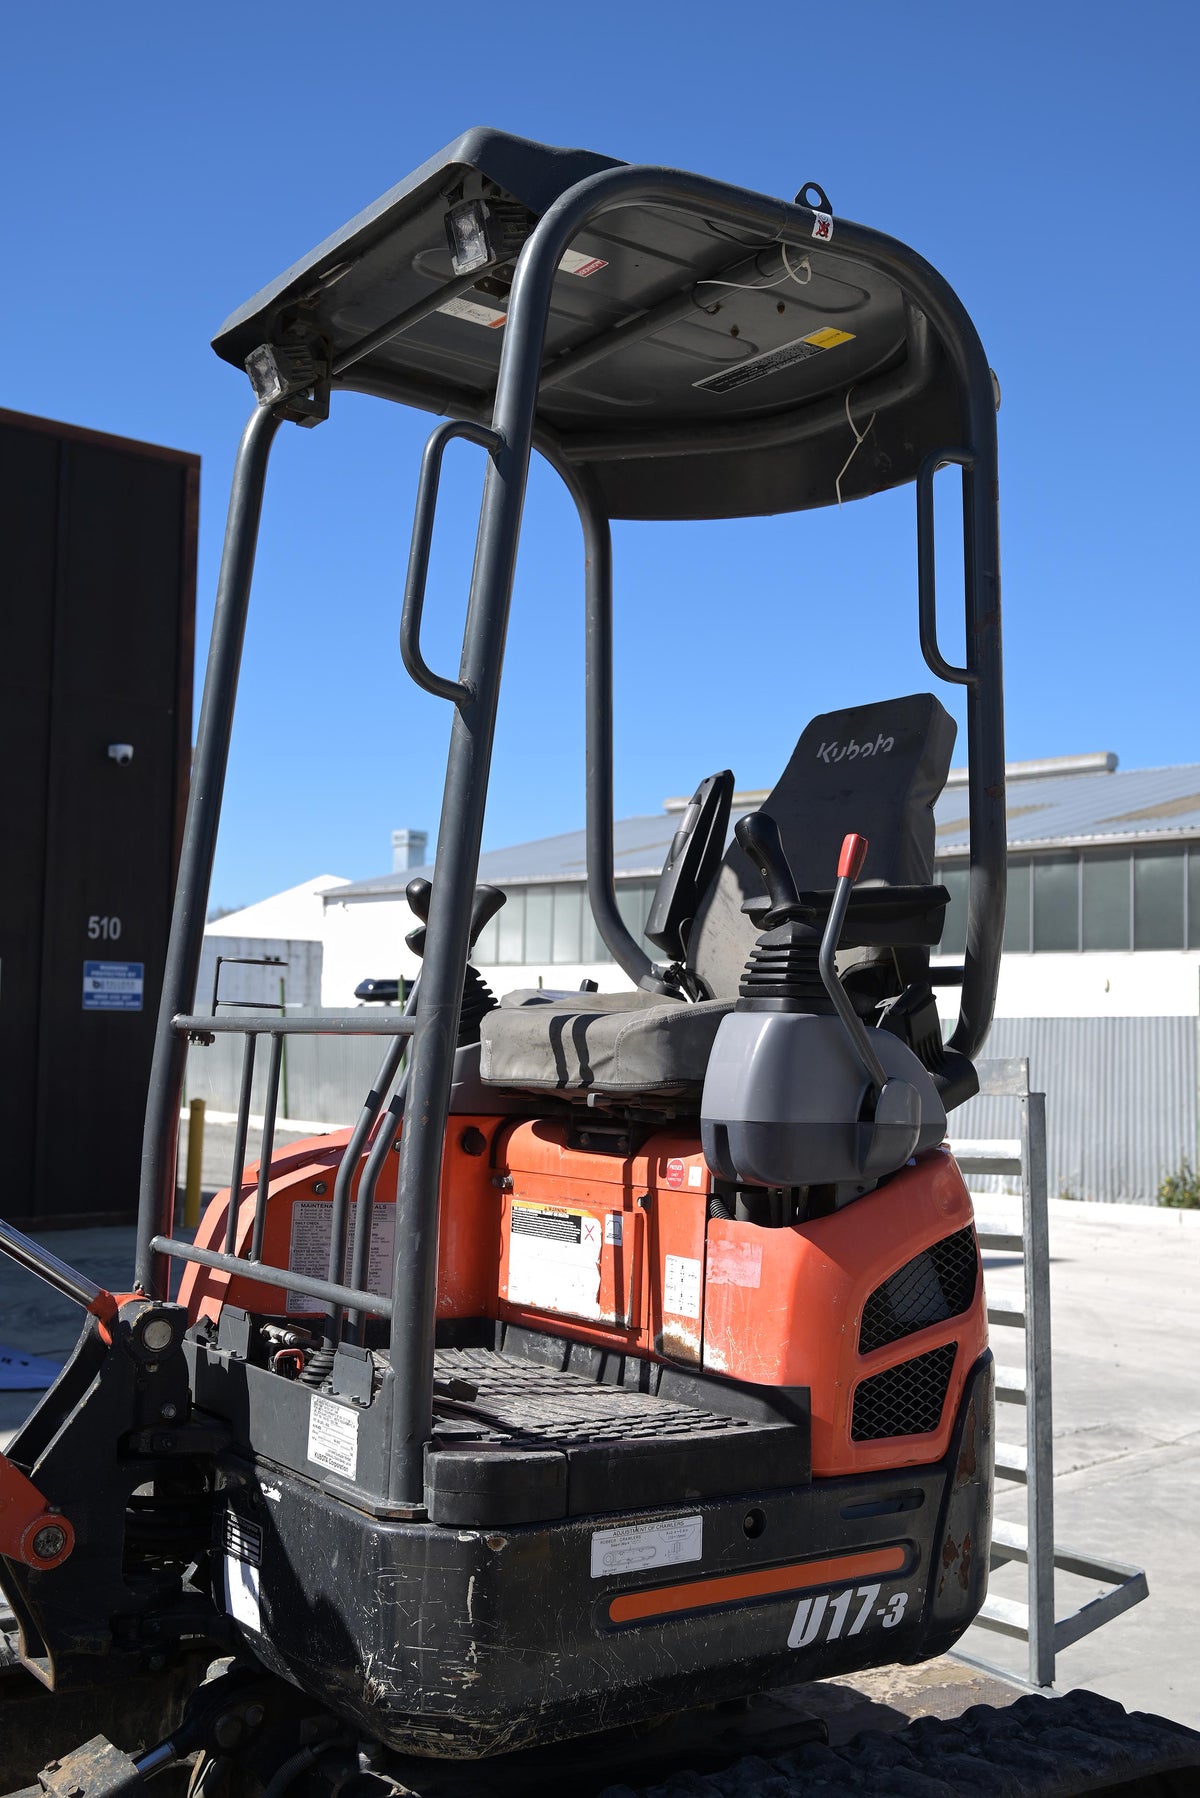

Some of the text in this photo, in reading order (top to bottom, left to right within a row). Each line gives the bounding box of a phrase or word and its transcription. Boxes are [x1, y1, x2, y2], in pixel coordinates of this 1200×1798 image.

[816, 733, 895, 763] Kubota
[87, 915, 121, 940] 510
[787, 1583, 908, 1648] U17-3
